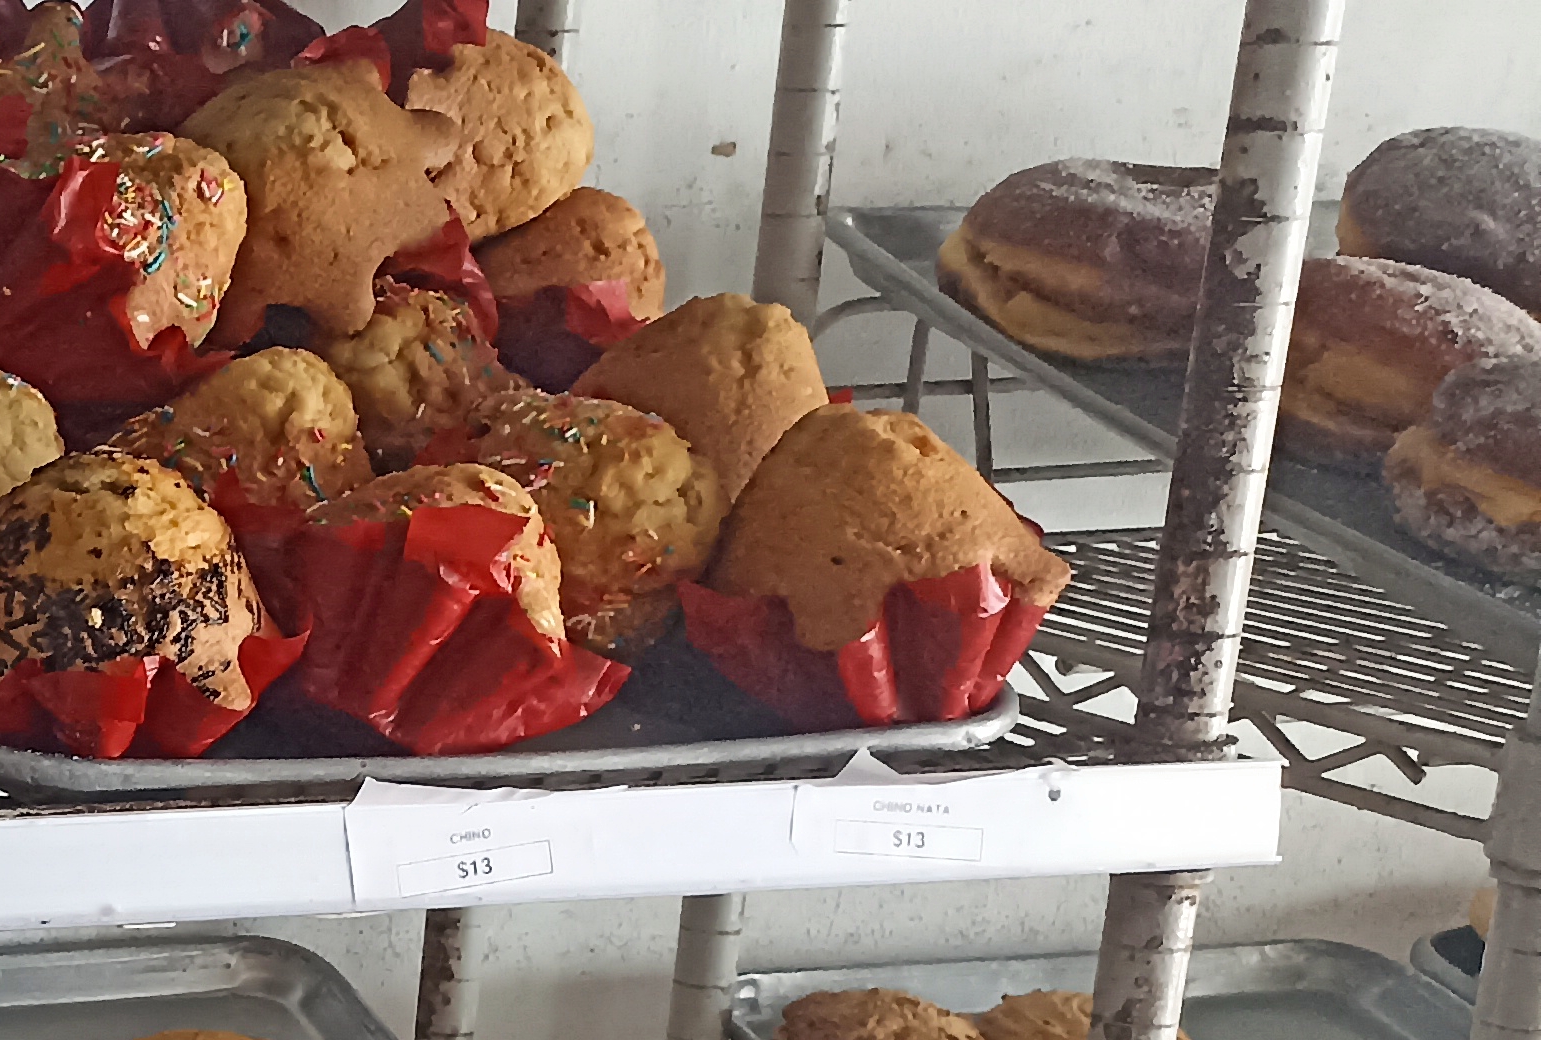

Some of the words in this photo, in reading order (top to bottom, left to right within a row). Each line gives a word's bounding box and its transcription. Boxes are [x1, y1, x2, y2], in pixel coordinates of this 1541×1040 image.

[450, 828, 491, 844] CHINO
[892, 830, 925, 848] $13
[457, 857, 493, 878] $13
